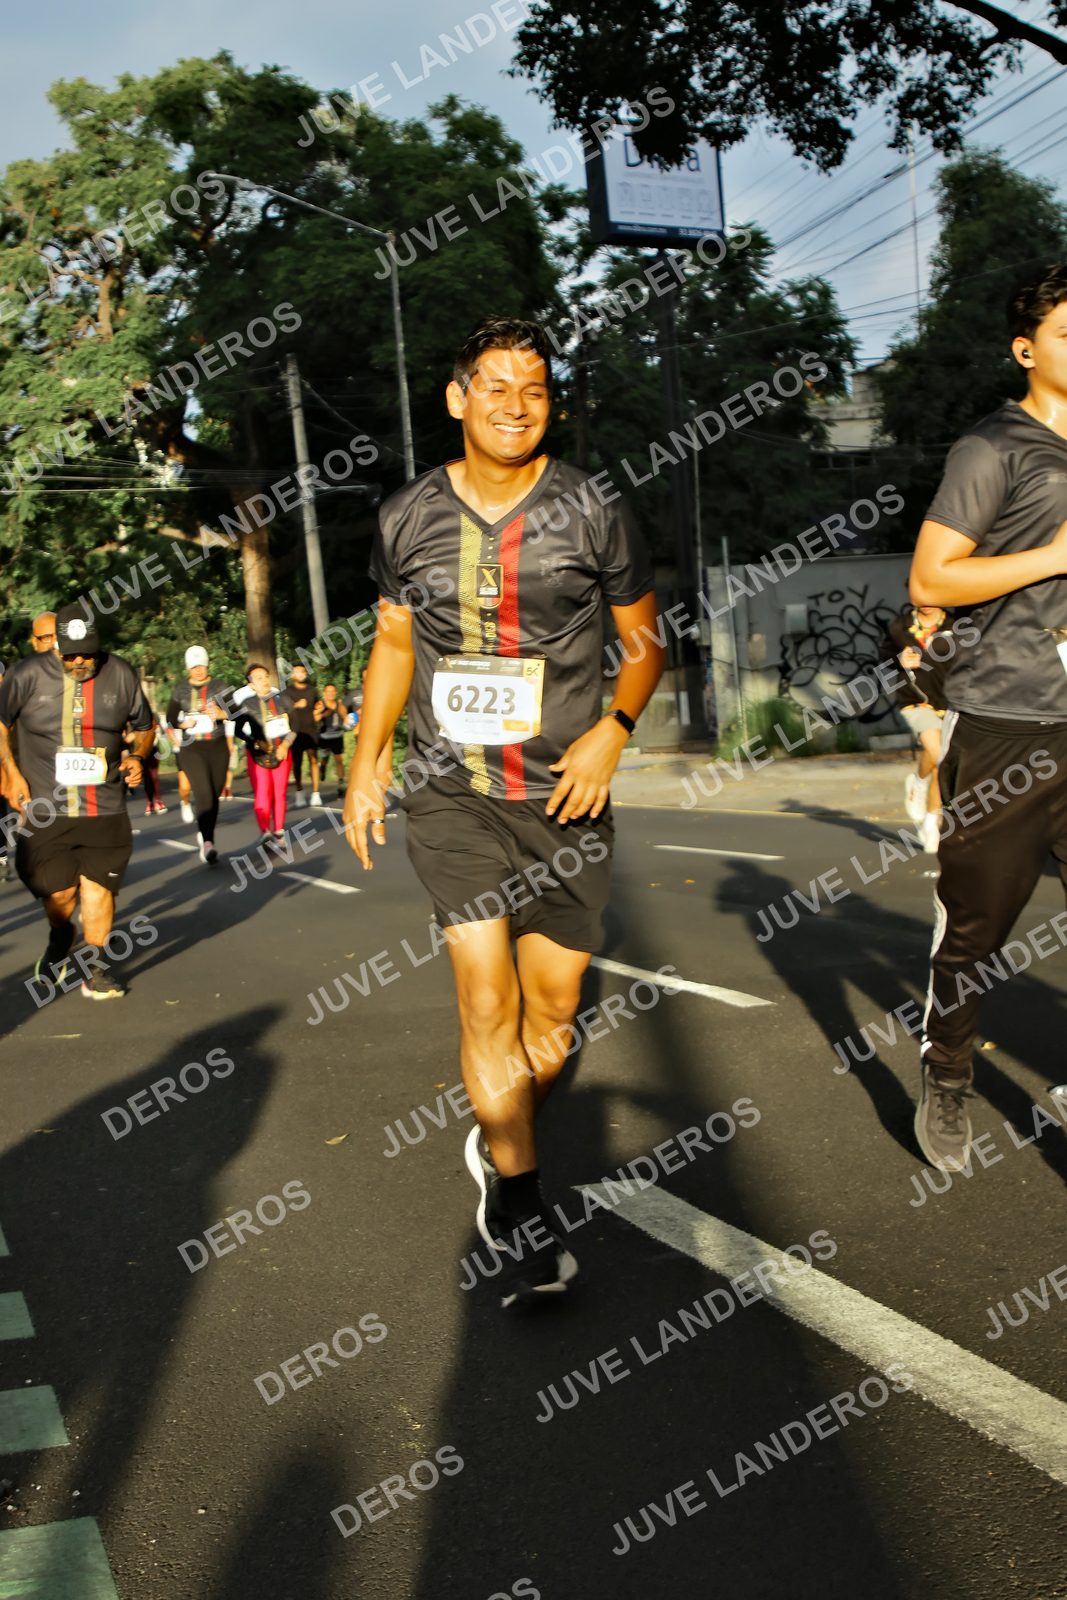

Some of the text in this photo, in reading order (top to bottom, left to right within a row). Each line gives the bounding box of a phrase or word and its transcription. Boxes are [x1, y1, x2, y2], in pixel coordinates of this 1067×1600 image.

[807, 584, 869, 609] TOY
[447, 684, 516, 715] 6223
[63, 758, 96, 772] 3022
